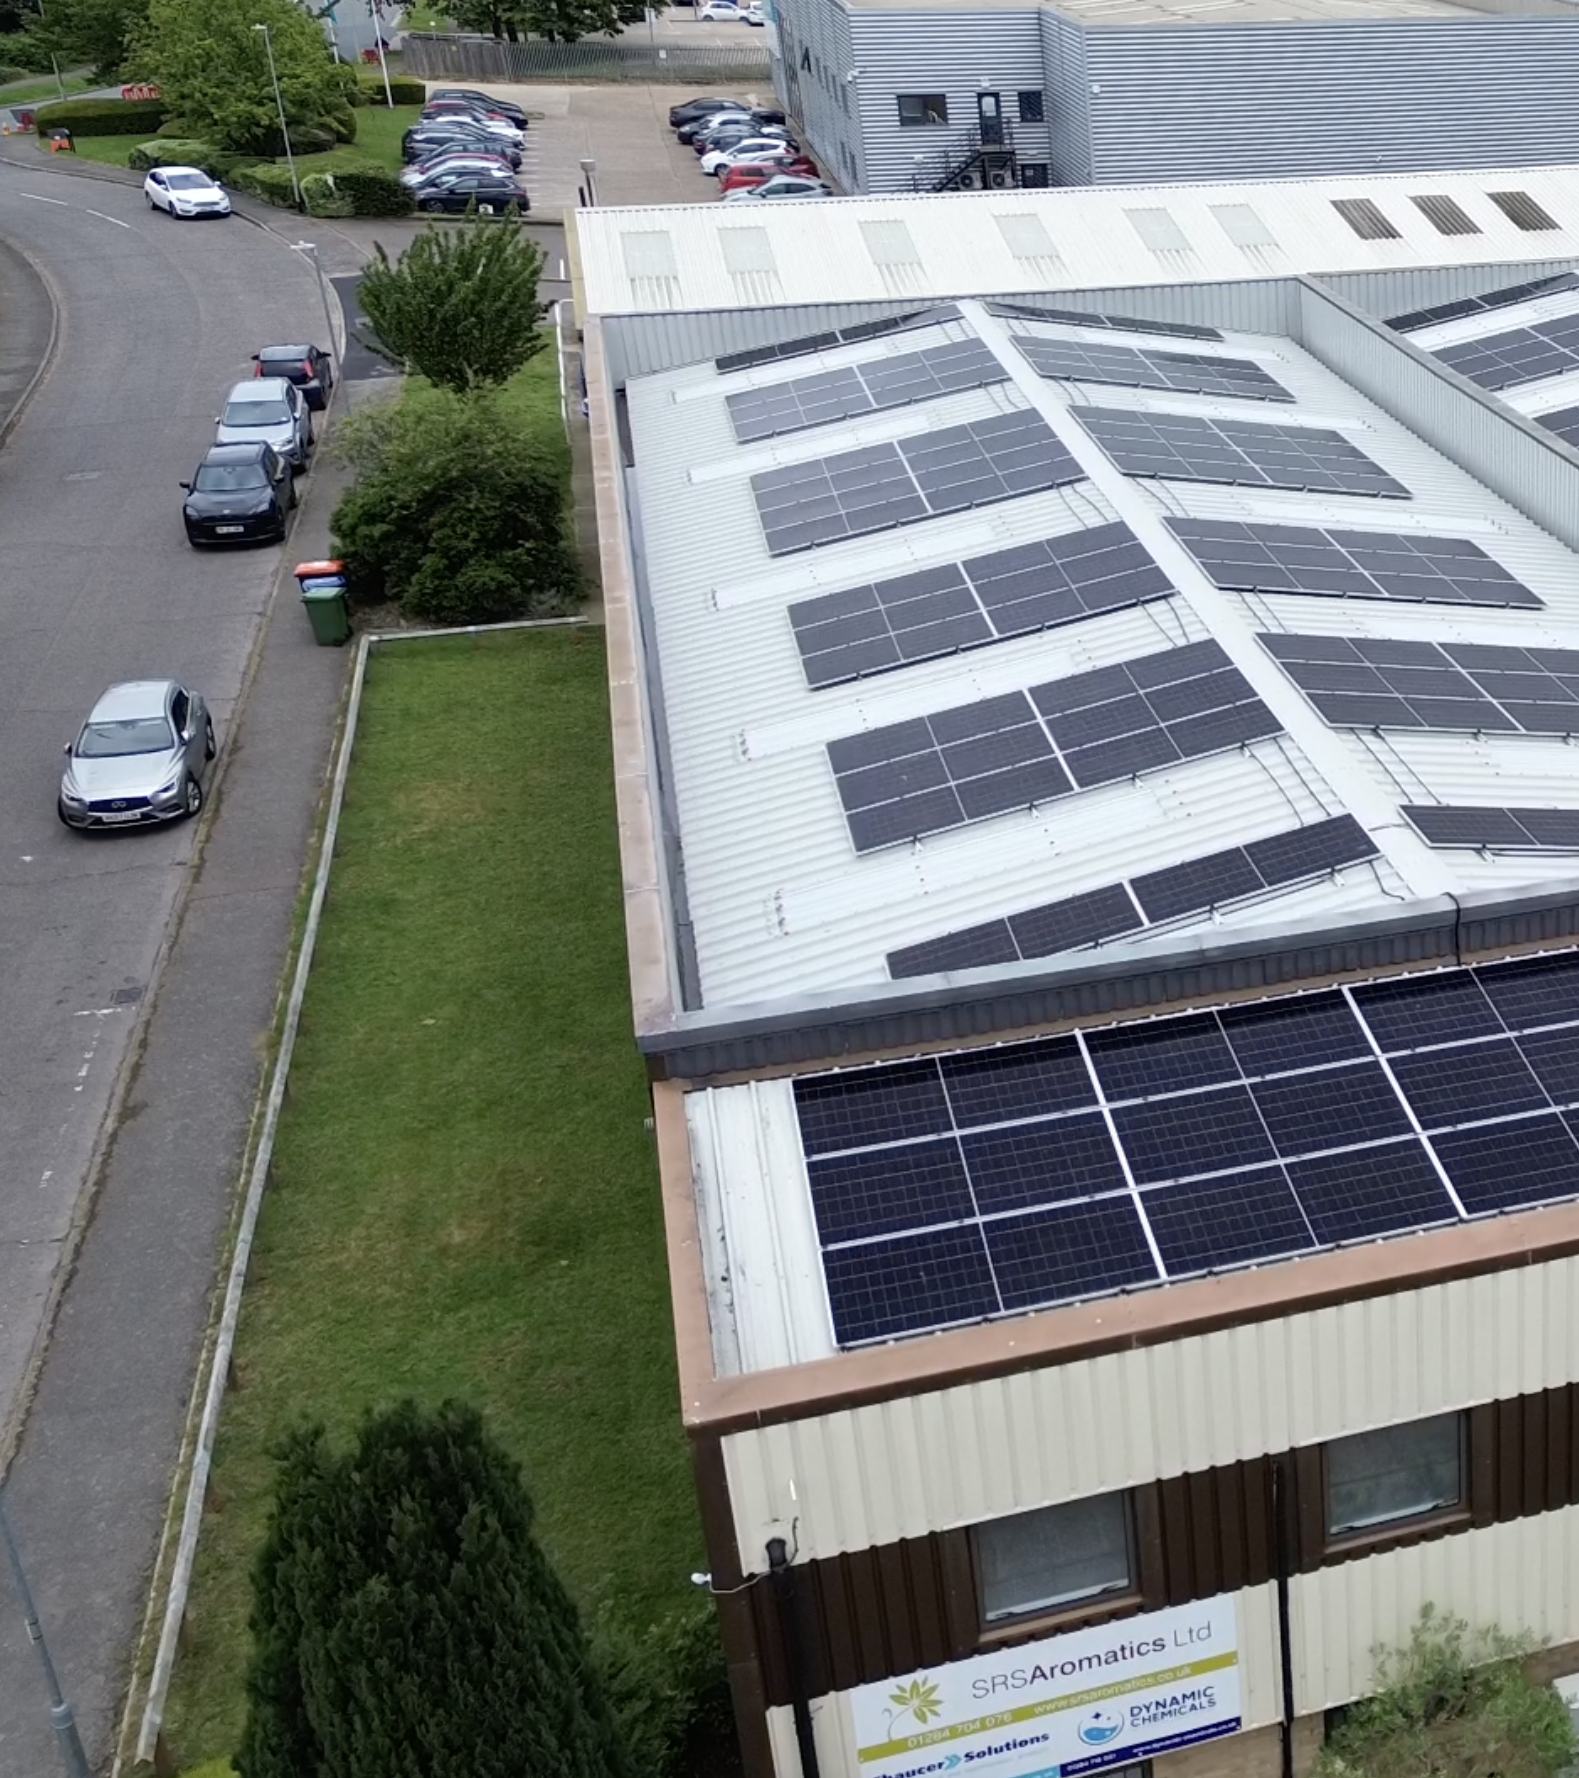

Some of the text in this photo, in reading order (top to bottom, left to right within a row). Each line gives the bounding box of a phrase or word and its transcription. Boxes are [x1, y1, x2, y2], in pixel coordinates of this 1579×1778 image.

[971, 1621, 1213, 1699] SRSAromatics Ltd
[907, 1667, 1193, 1748] 01284 704 076 www.srsaromatics.co.uk
[1130, 1686, 1216, 1718] DYNAMIC
[1130, 1697, 1217, 1728] CHEMICALS
[873, 1761, 945, 1778] aucer
[963, 1732, 1050, 1763] Solutions
